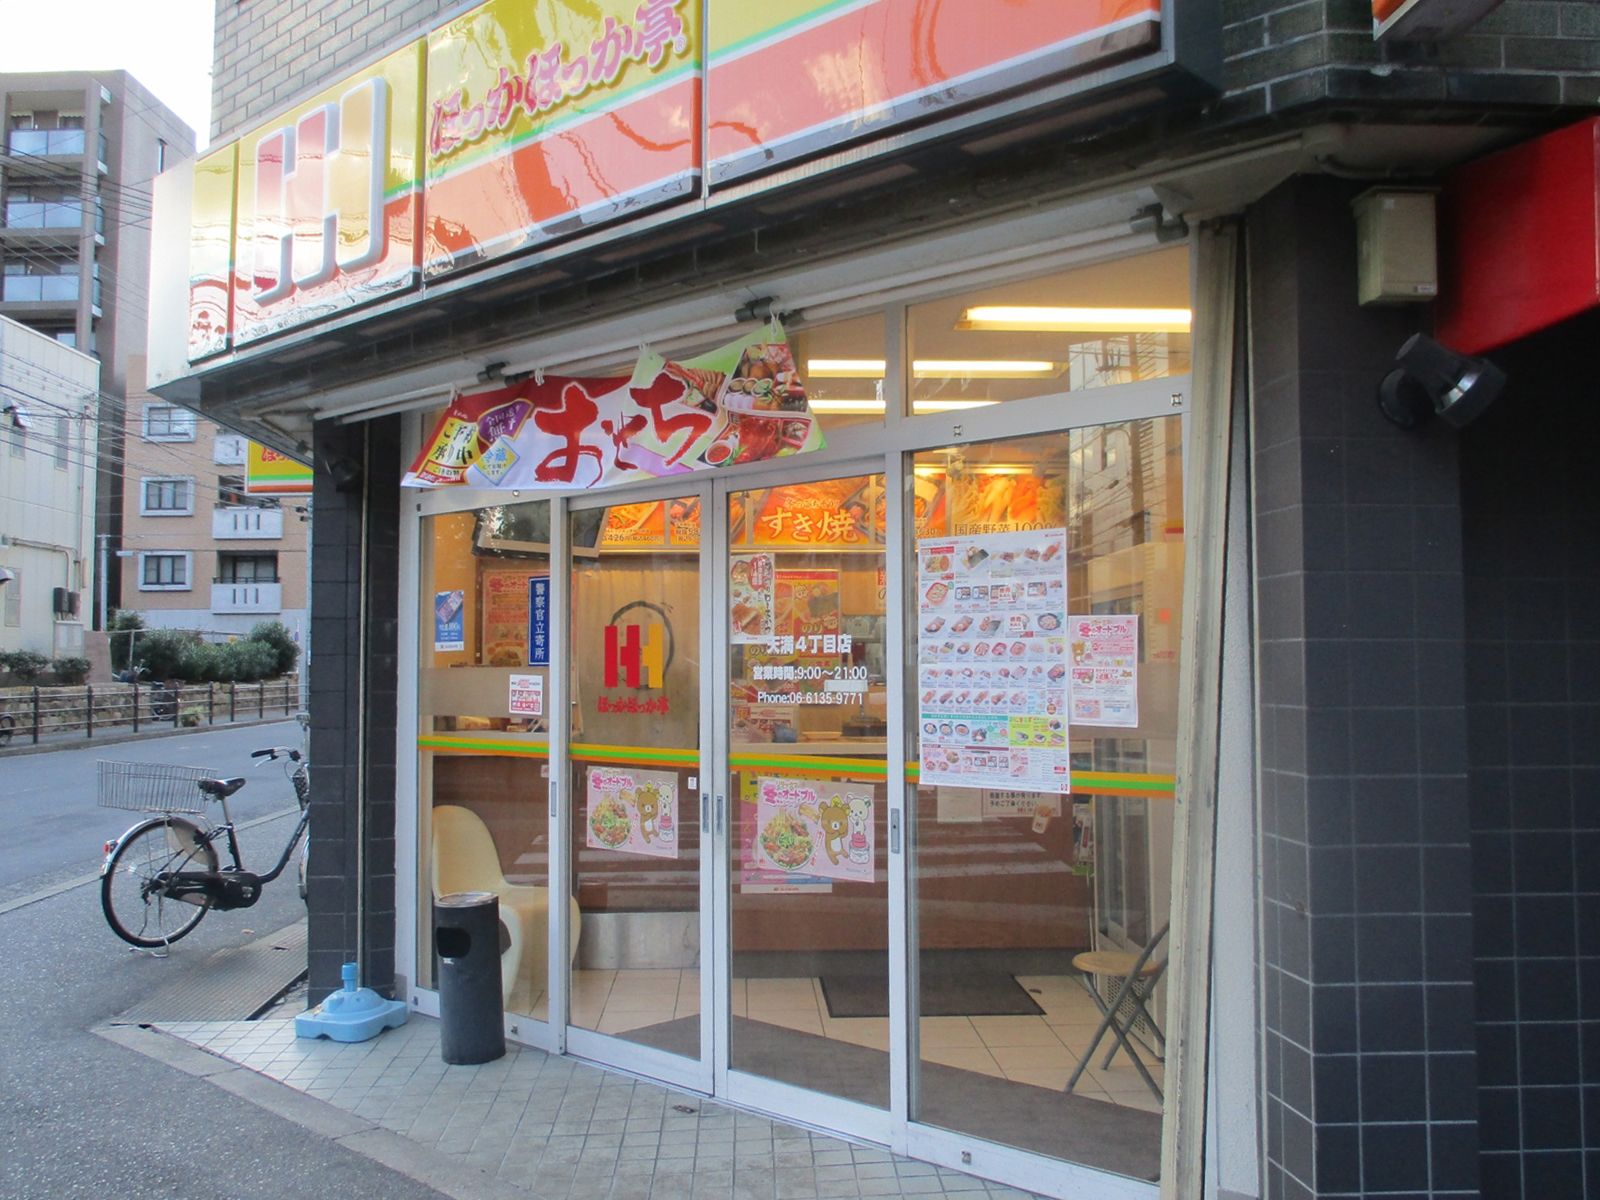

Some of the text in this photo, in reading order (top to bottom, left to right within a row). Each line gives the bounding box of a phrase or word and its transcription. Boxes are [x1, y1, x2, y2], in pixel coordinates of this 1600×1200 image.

[761, 507, 858, 542] すき焼
[535, 582, 545, 660] 警察官立寄所
[766, 634, 852, 654] 天満4丁目店
[757, 692, 863, 705] Phone:06-6135-9771
